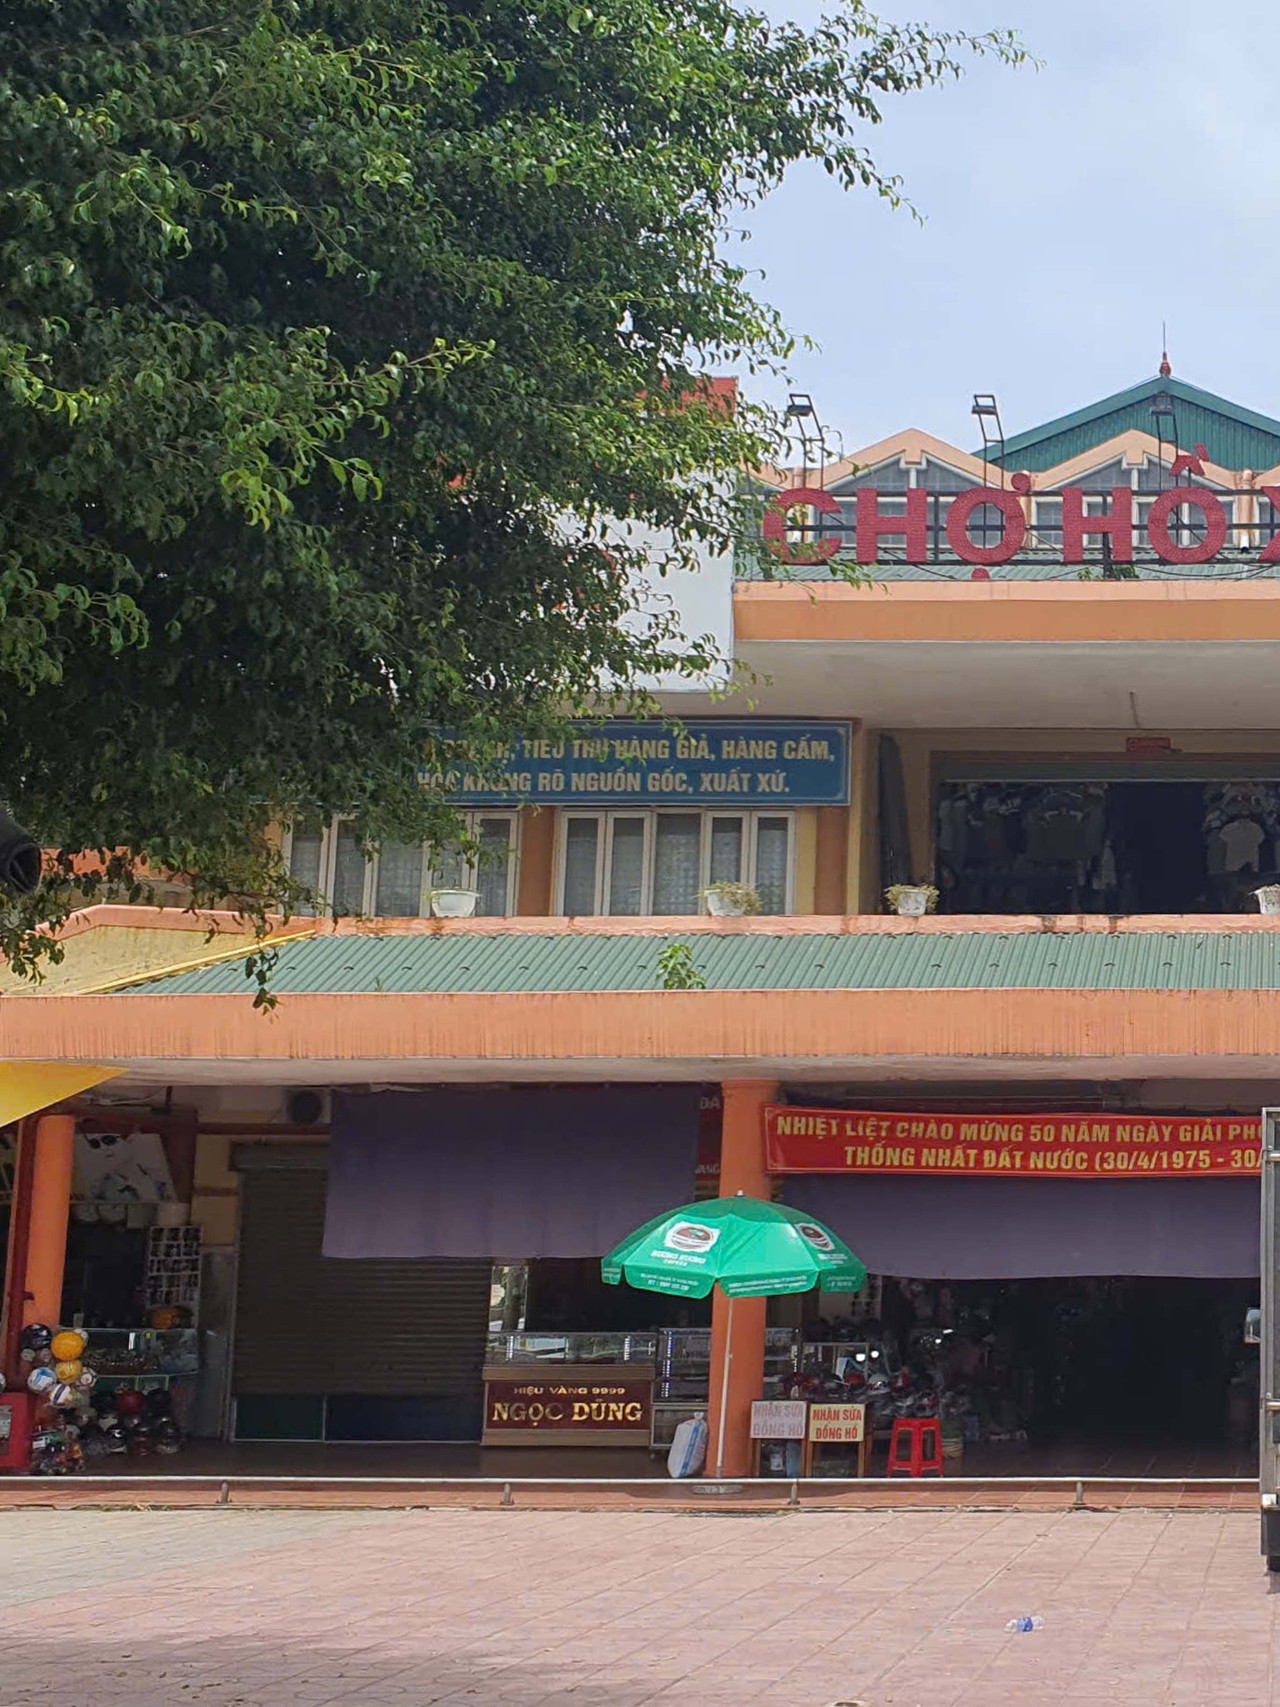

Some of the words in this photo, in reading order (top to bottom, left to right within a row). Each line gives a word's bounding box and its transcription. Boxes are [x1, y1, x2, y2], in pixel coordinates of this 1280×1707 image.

[763, 471, 1031, 580] CHỢ
[1062, 444, 1227, 564] HỒ
[722, 736, 777, 760] HÀNG
[783, 734, 835, 762] CẤM,
[538, 769, 565, 792] RÕ
[700, 766, 751, 793] XUẤT
[776, 1115, 839, 1140] NHIỆT
[845, 1117, 890, 1140] LIỆT
[896, 1118, 954, 1140] CHÀO
[960, 1119, 1024, 1142] MỪNG
[1029, 1124, 1055, 1142] 50
[1061, 1121, 1110, 1142] NĂM
[1116, 1121, 1173, 1143] NGÀY
[1179, 1118, 1222, 1143] GIẢI
[845, 1140, 915, 1167] THỐNG
[920, 1142, 978, 1168] NHẤT
[983, 1145, 1024, 1169] ĐẤT
[1030, 1148, 1088, 1170] NƯỚC
[1095, 1149, 1212, 1172] (30/4/1975
[514, 1385, 544, 1396] HIỆU
[550, 1385, 588, 1395] VÀNG
[592, 1387, 625, 1395] 9999
[492, 1402, 564, 1426] NGỌC
[572, 1399, 643, 1421] DŨNG
